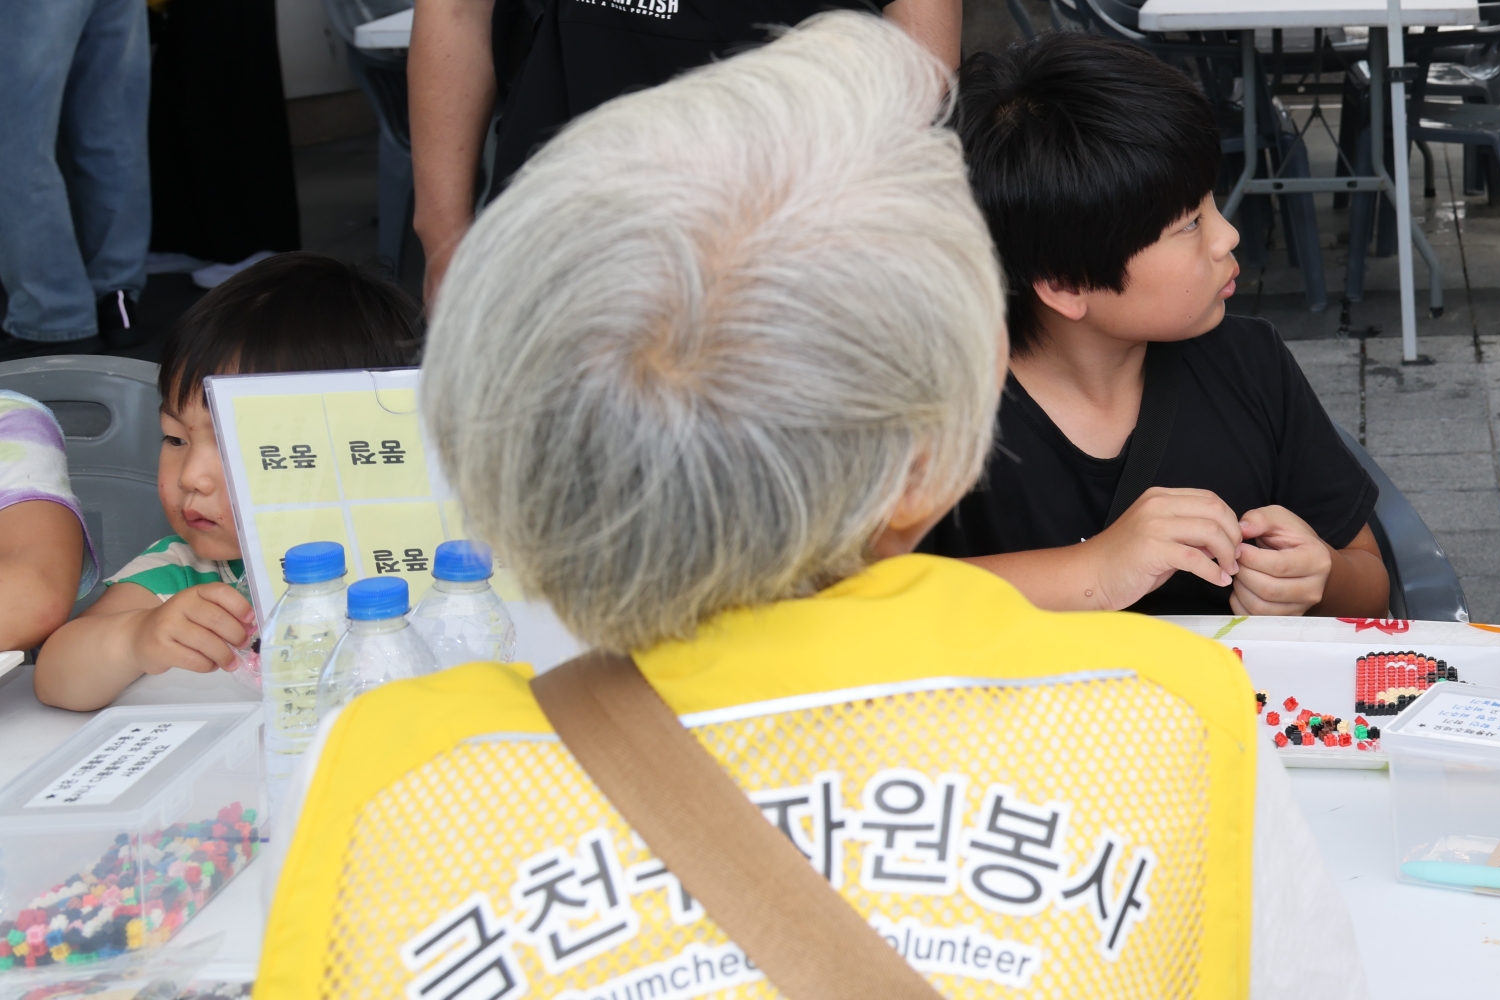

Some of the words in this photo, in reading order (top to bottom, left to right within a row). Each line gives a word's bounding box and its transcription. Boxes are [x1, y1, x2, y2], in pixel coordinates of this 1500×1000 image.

[259, 444, 317, 471] 품절
[349, 439, 406, 466] 품절
[373, 548, 429, 574] 품절
[877, 926, 1032, 977] olunteer
